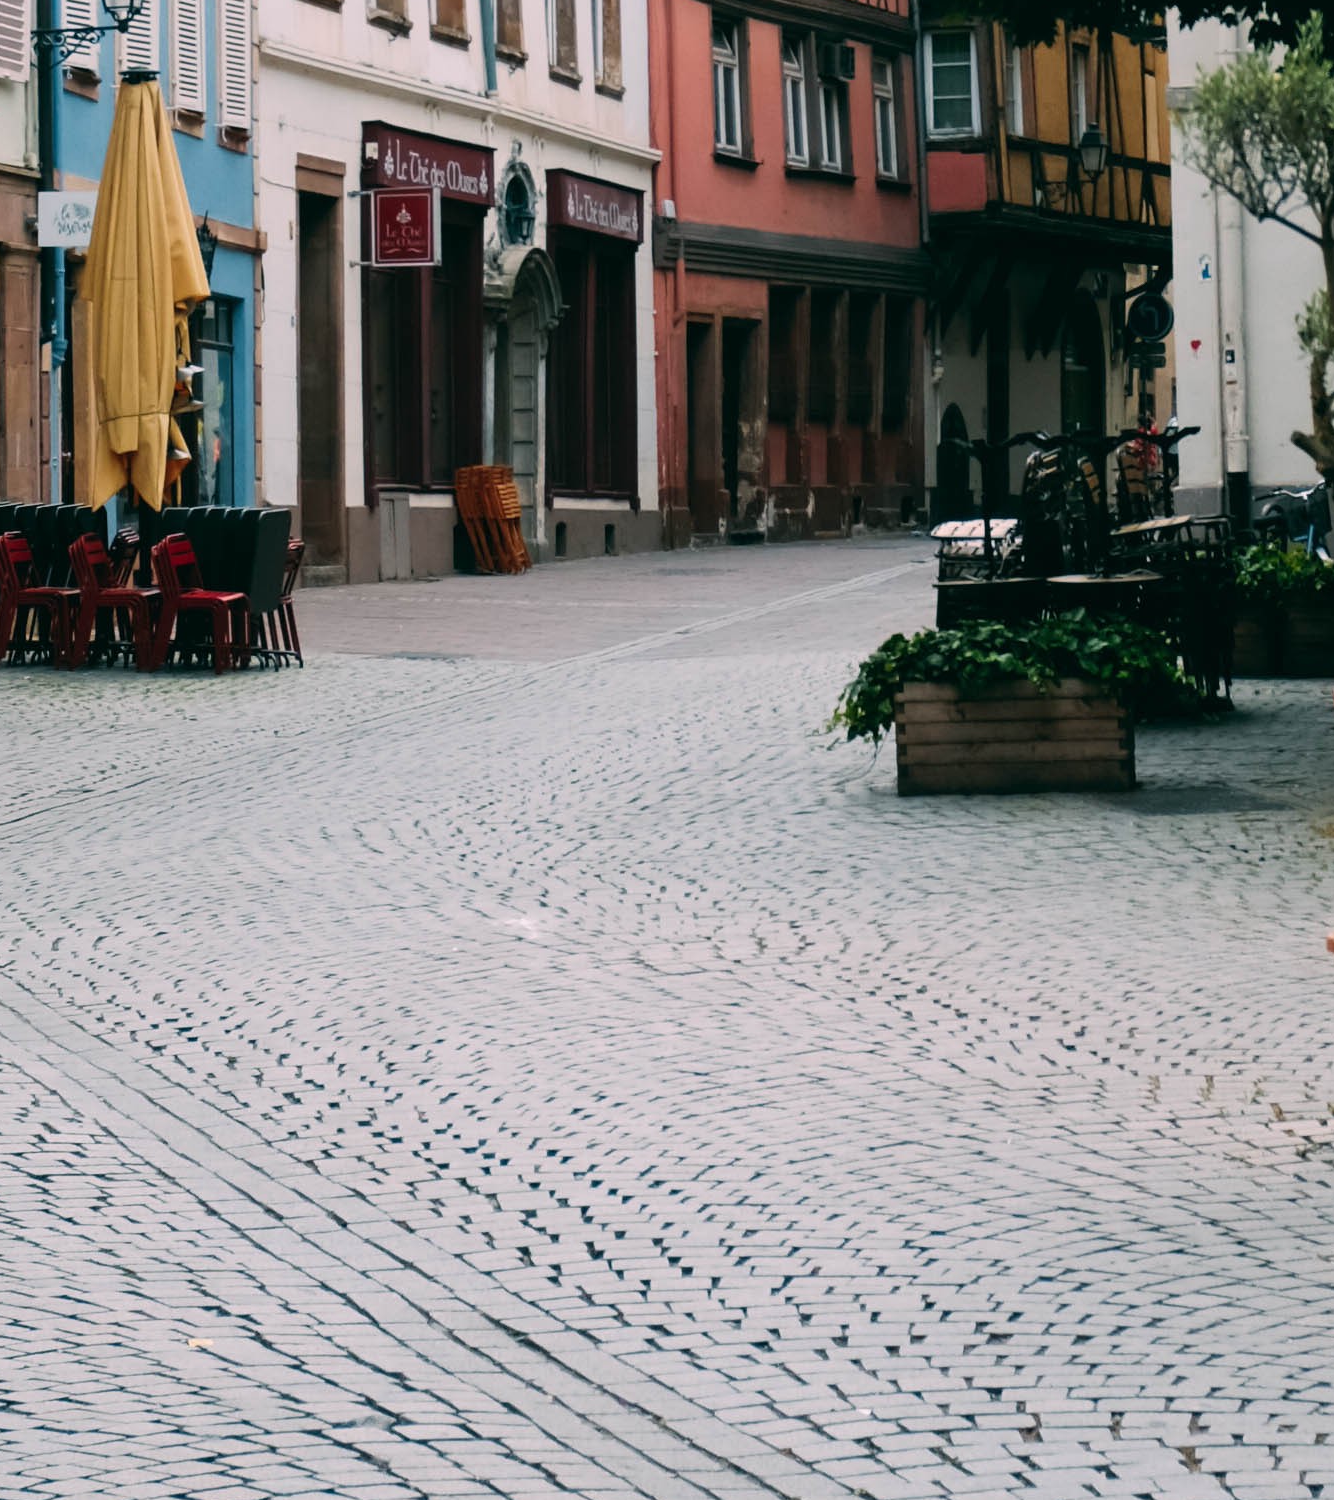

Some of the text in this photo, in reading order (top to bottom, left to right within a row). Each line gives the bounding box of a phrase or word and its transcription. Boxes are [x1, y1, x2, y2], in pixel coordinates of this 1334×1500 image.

[396, 139, 479, 195] Le Thé des Muses
[574, 184, 584, 221] Le
